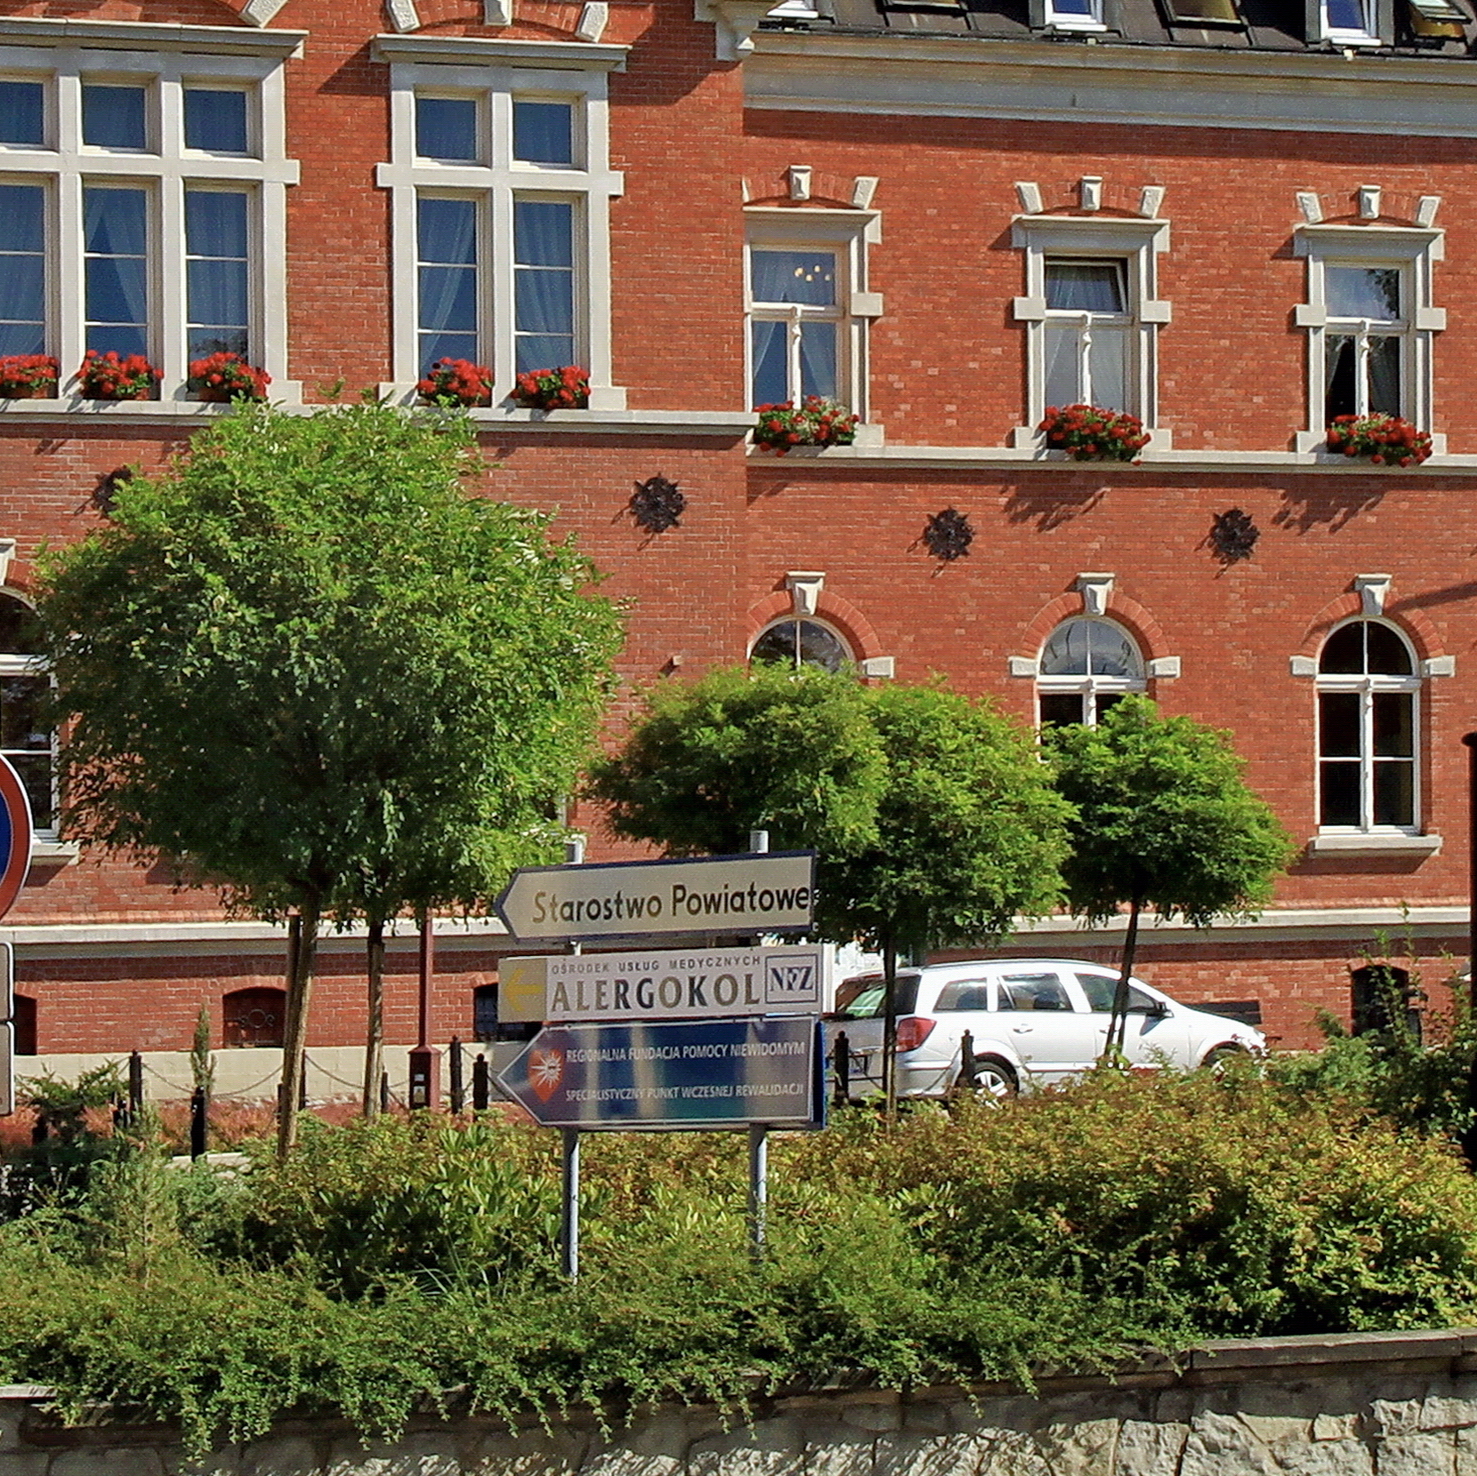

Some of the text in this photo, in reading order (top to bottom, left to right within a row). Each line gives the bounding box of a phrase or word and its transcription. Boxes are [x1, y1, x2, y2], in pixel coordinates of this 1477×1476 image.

[532, 880, 810, 924] Starostwo Powiatowe
[552, 955, 761, 974] OŚRODEK USŁUG MEDYCZNYCH
[770, 966, 814, 992] NFZ
[552, 973, 760, 1012] ALERGOKOL
[566, 1041, 806, 1063] REGIONALNA FUNDACJA POMOCY NIEWIDOMYM
[566, 1082, 805, 1102] SPECJALISTYCZNY PUNKT WCZESNEJ REWALIDACJI
